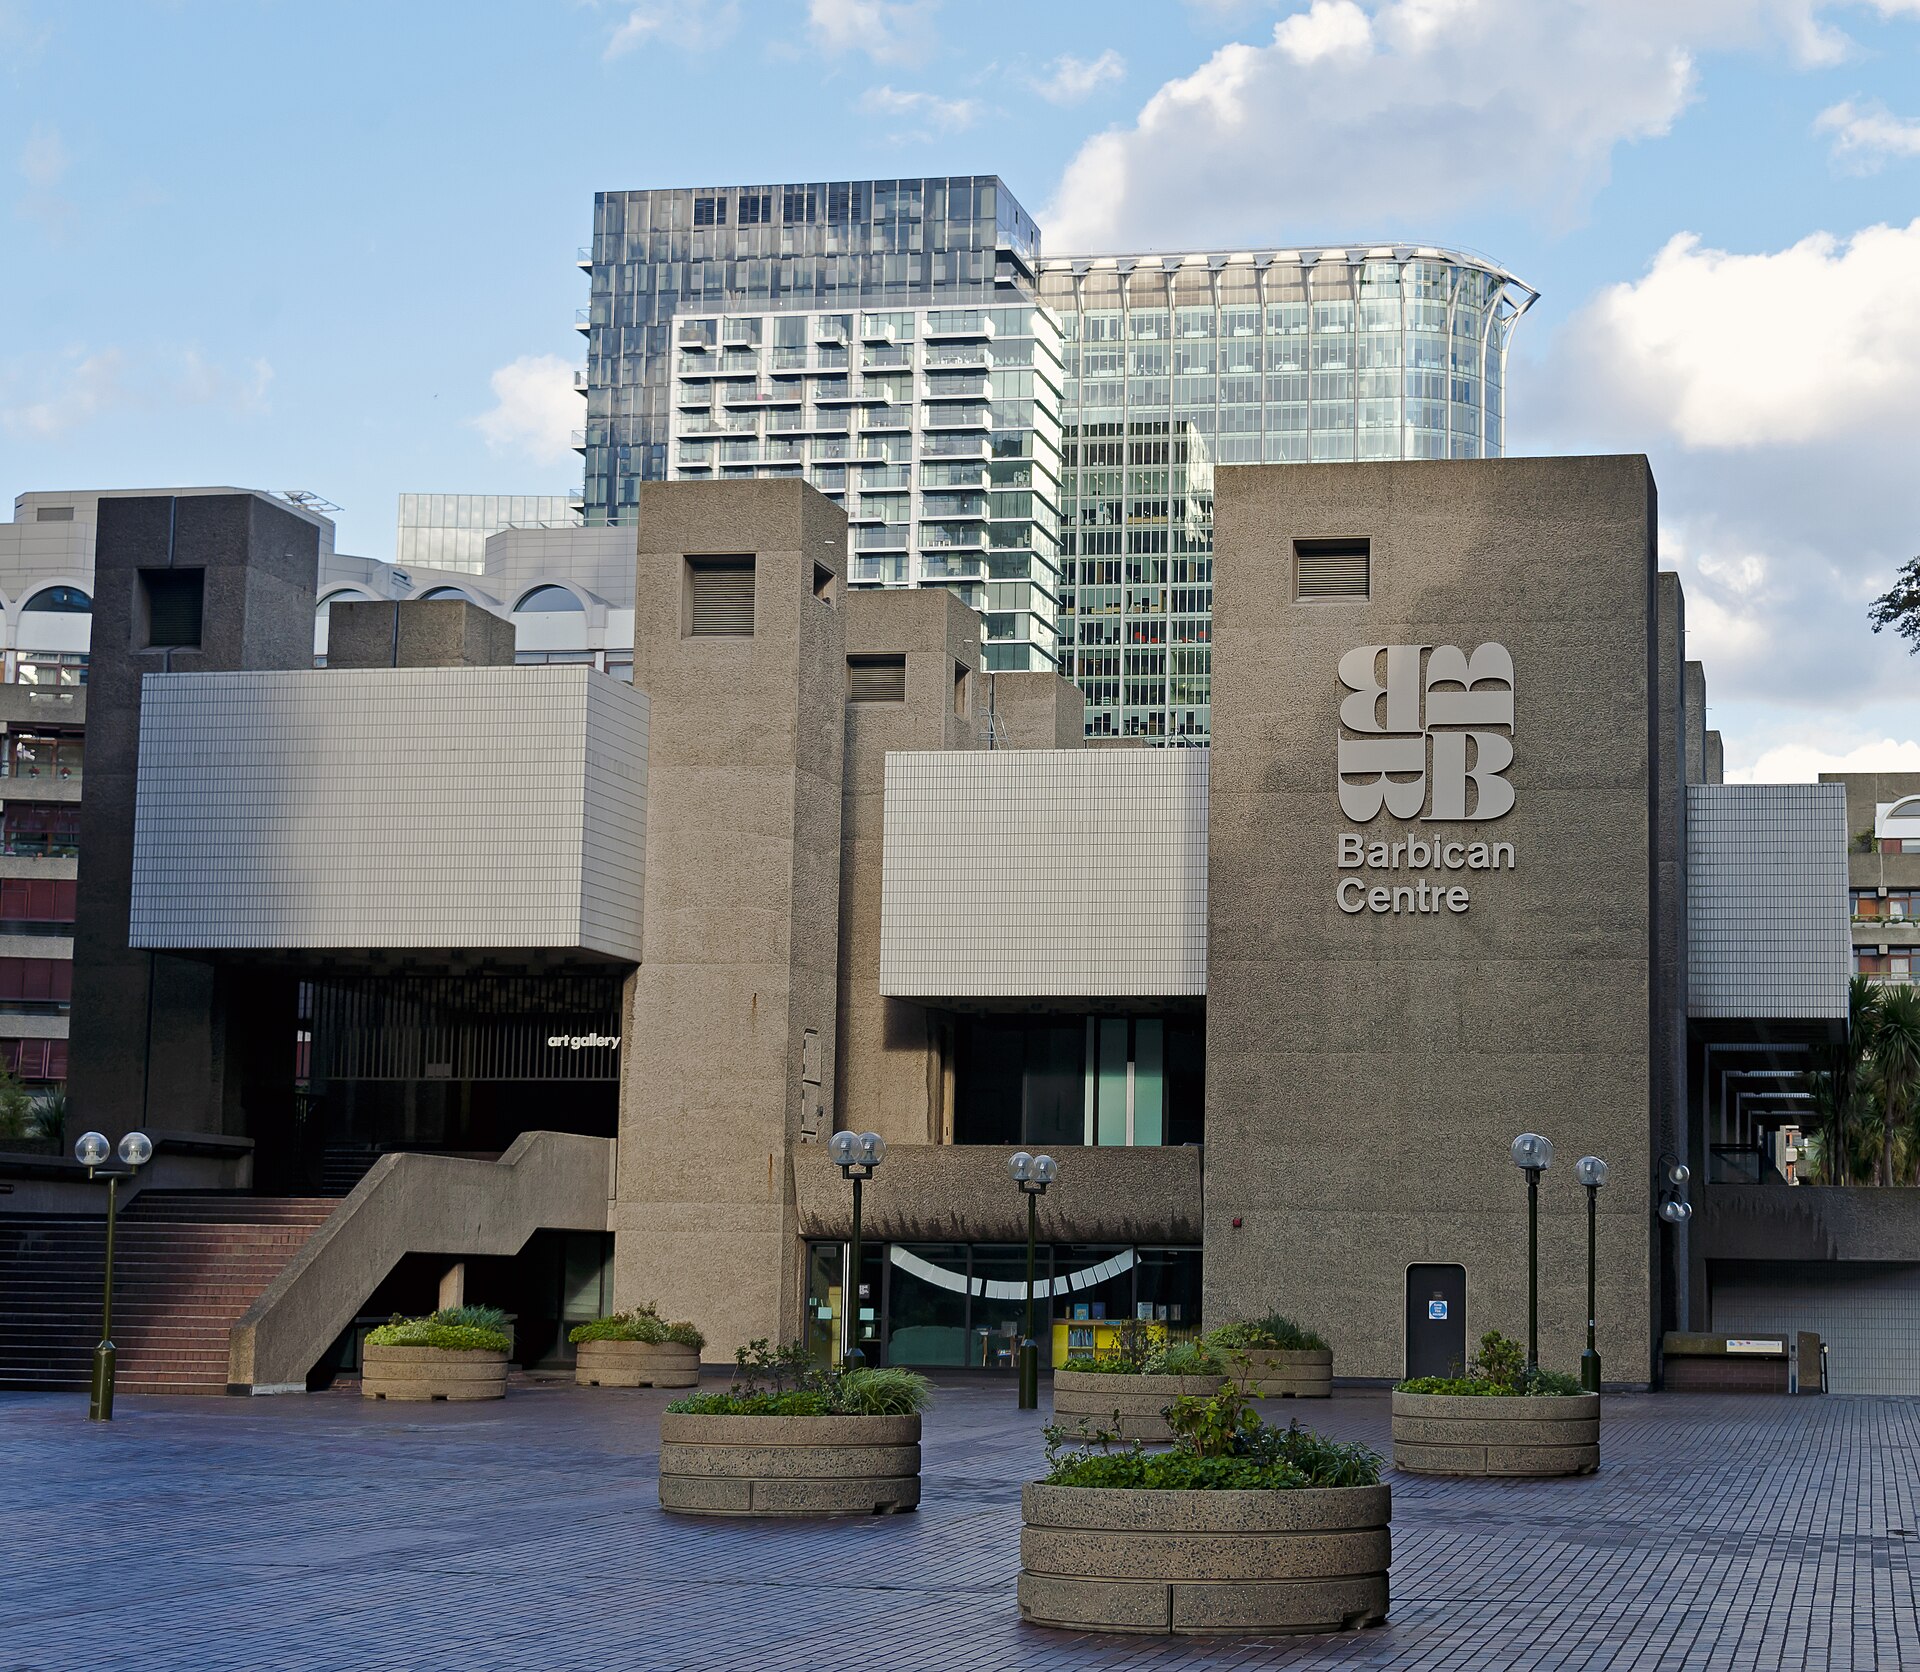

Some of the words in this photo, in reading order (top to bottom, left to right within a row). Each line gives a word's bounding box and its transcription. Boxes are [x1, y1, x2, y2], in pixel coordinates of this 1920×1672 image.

[1337, 833, 1515, 869] Barbican
[1336, 877, 1470, 913] Centre
[547, 1034, 570, 1047] art
[570, 1033, 621, 1050] gallery
